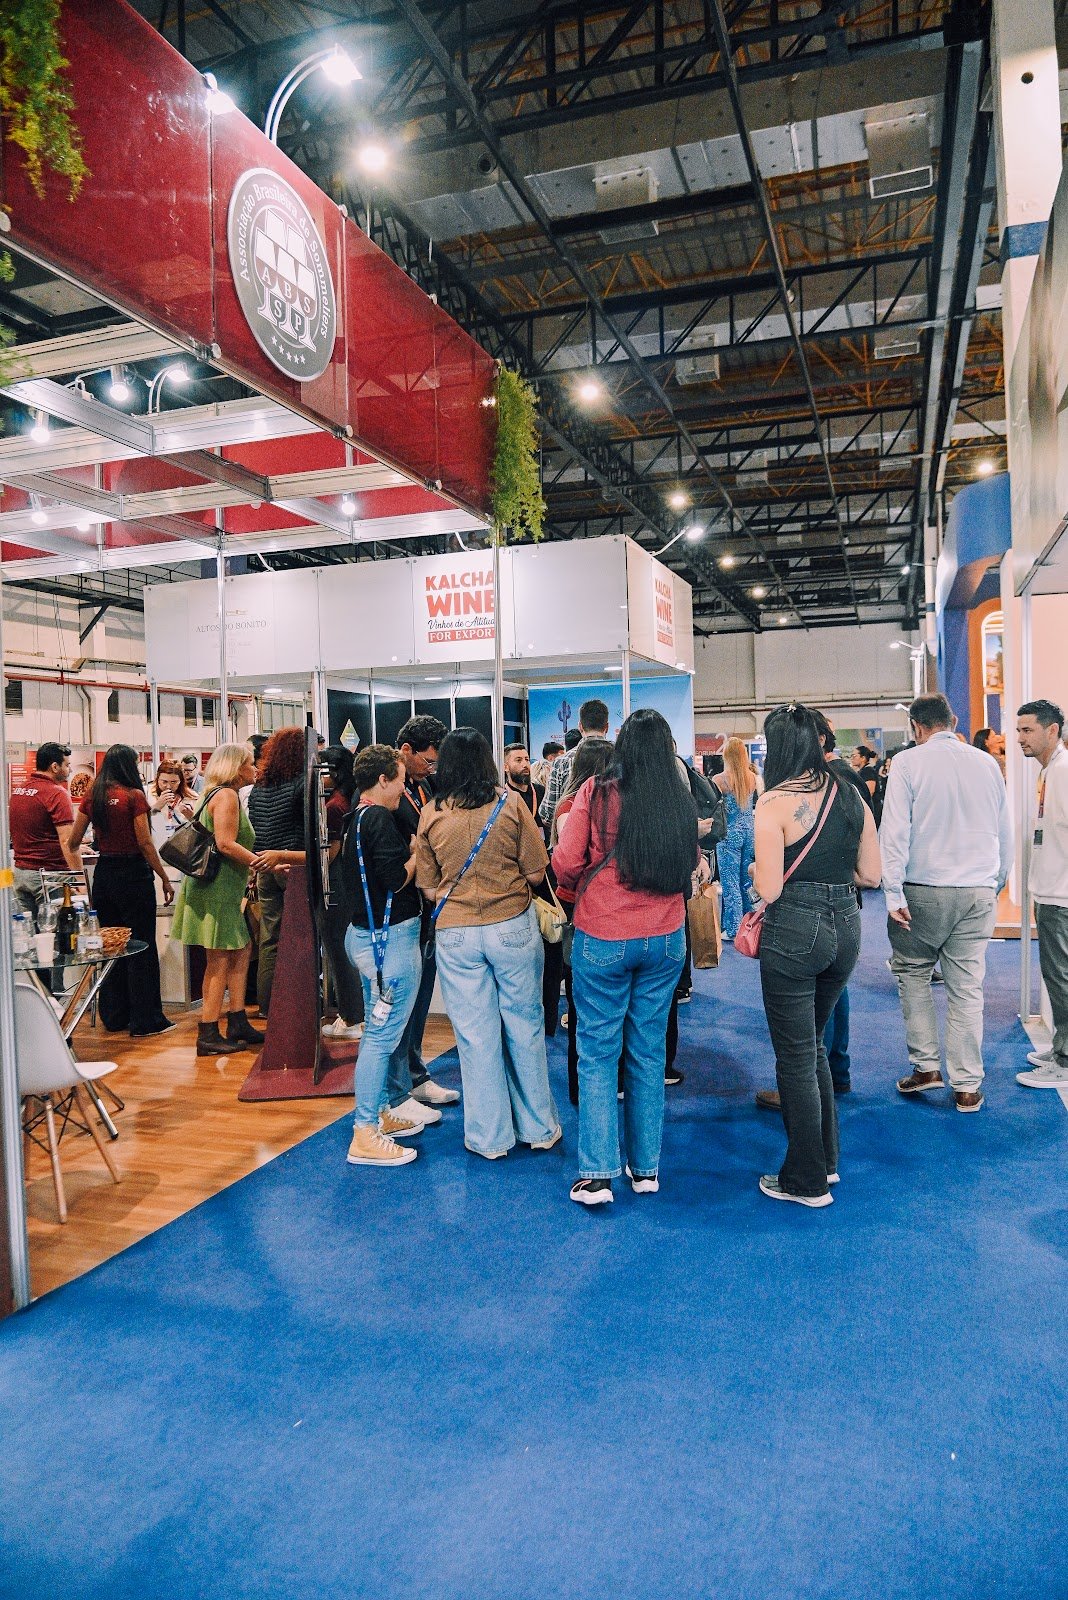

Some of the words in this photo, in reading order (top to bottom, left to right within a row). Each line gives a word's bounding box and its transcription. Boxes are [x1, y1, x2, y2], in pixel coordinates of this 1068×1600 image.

[239, 194, 256, 283] Associação
[253, 183, 298, 216] Brasileira
[299, 216, 311, 238] de
[309, 240, 330, 339] Sommeliers
[425, 570, 495, 591] KALCHA
[654, 577, 672, 601] KALCHA
[426, 589, 495, 618] WINE
[655, 595, 673, 625] WINE
[195, 624, 221, 633] ALTOS
[235, 619, 267, 630] BONITO
[428, 619, 454, 630] Vinhos
[454, 618, 465, 628] de
[430, 631, 452, 642] FOR
